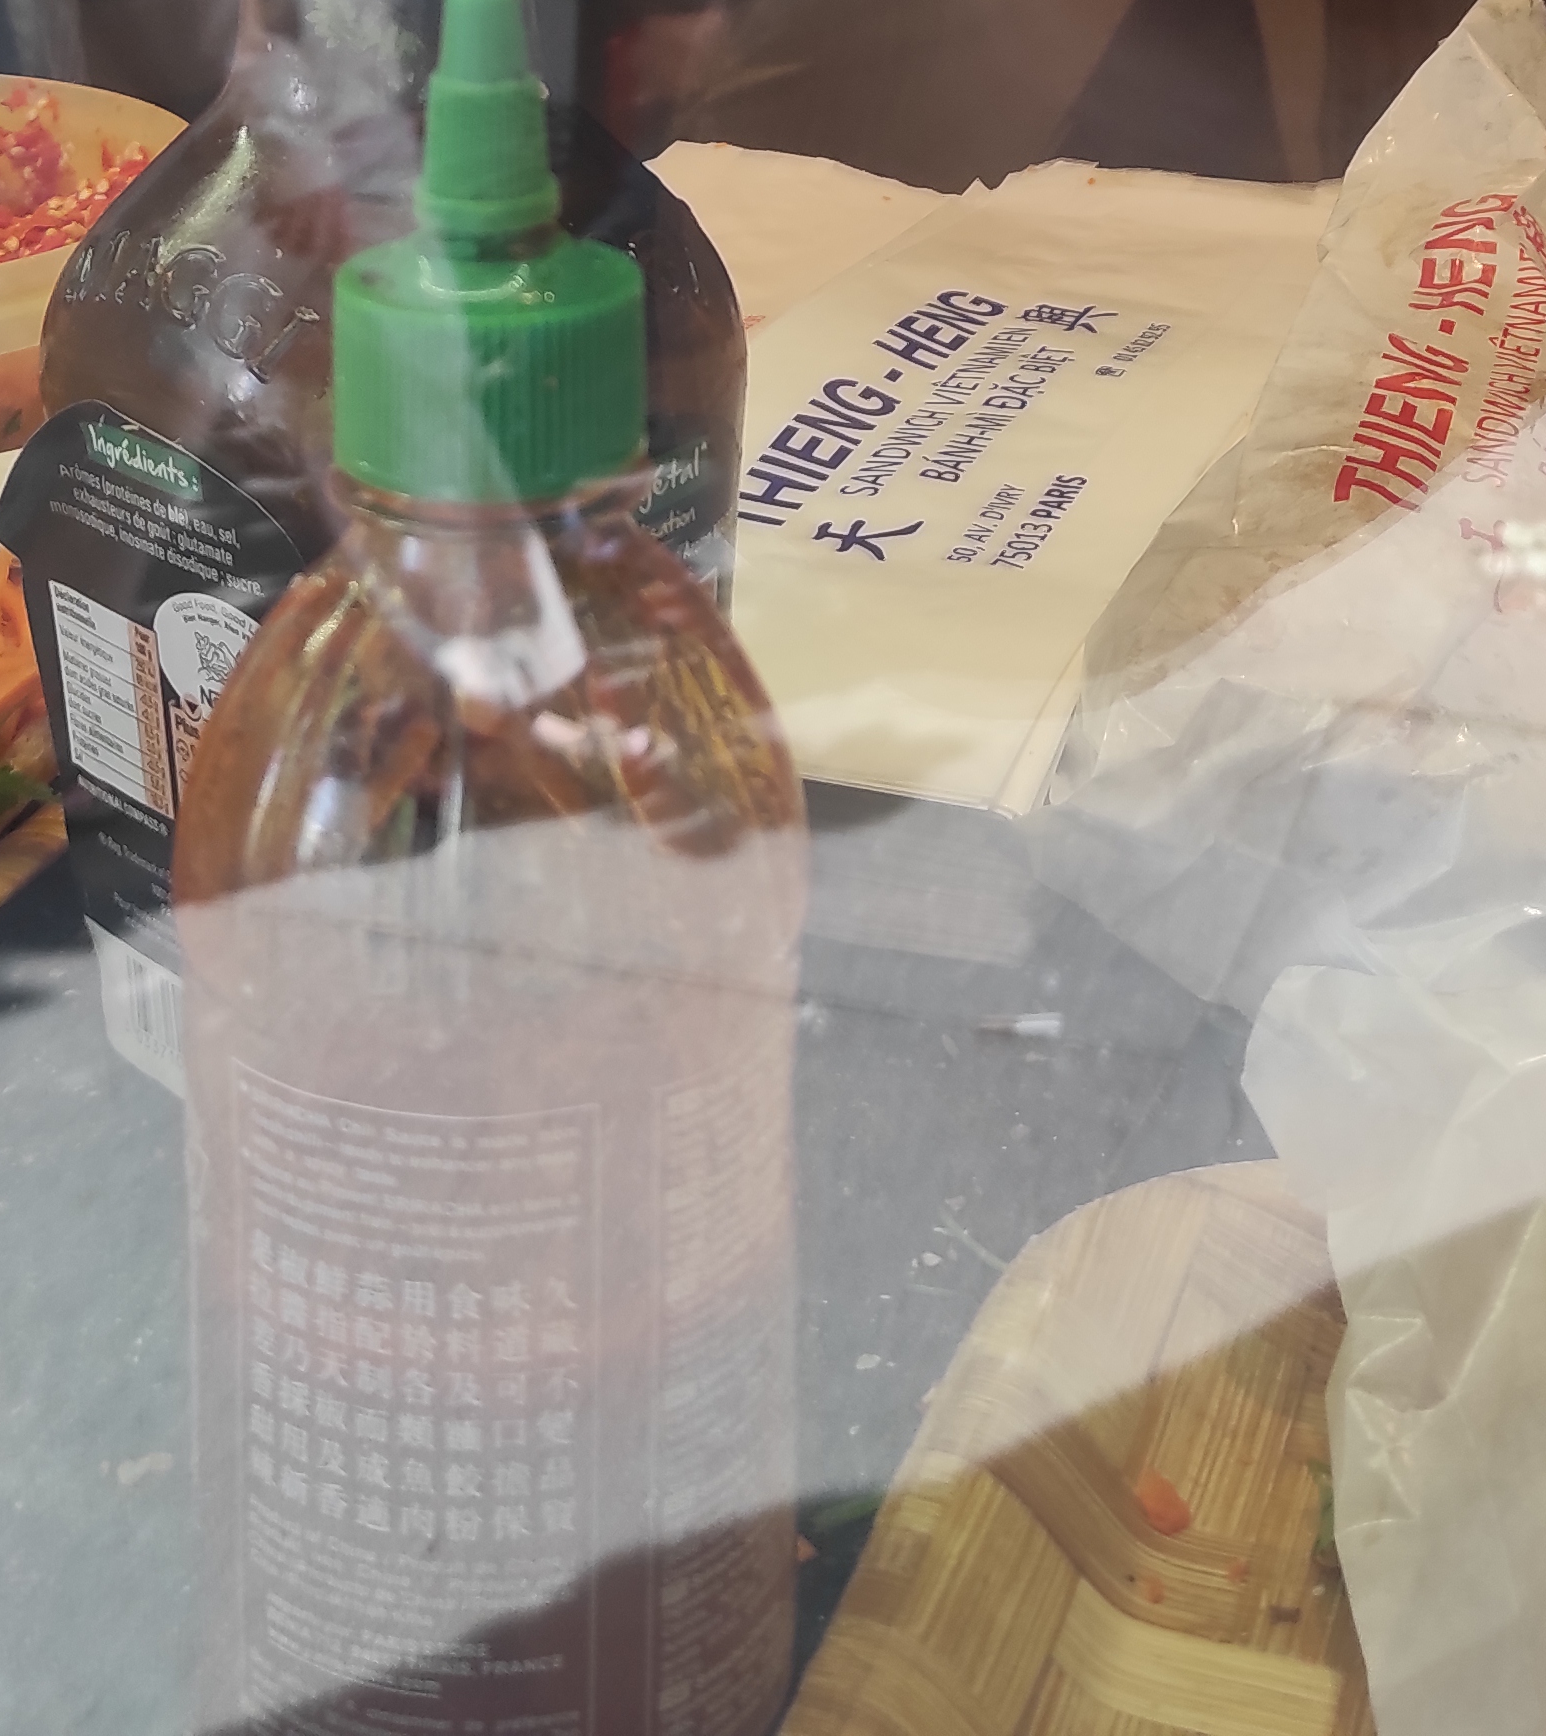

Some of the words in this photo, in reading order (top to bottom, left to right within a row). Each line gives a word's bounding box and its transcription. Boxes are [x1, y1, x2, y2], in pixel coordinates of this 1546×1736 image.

[872, 289, 1009, 371] HENG
[1334, 333, 1470, 513] THIENG
[1408, 193, 1519, 317] HENG
[87, 422, 189, 489] Ingrédients
[839, 408, 955, 497] SANDWICH
[1462, 370, 1531, 489] SANDWICH
[989, 521, 1054, 571] 75013
[1029, 473, 1089, 521] PARIS
